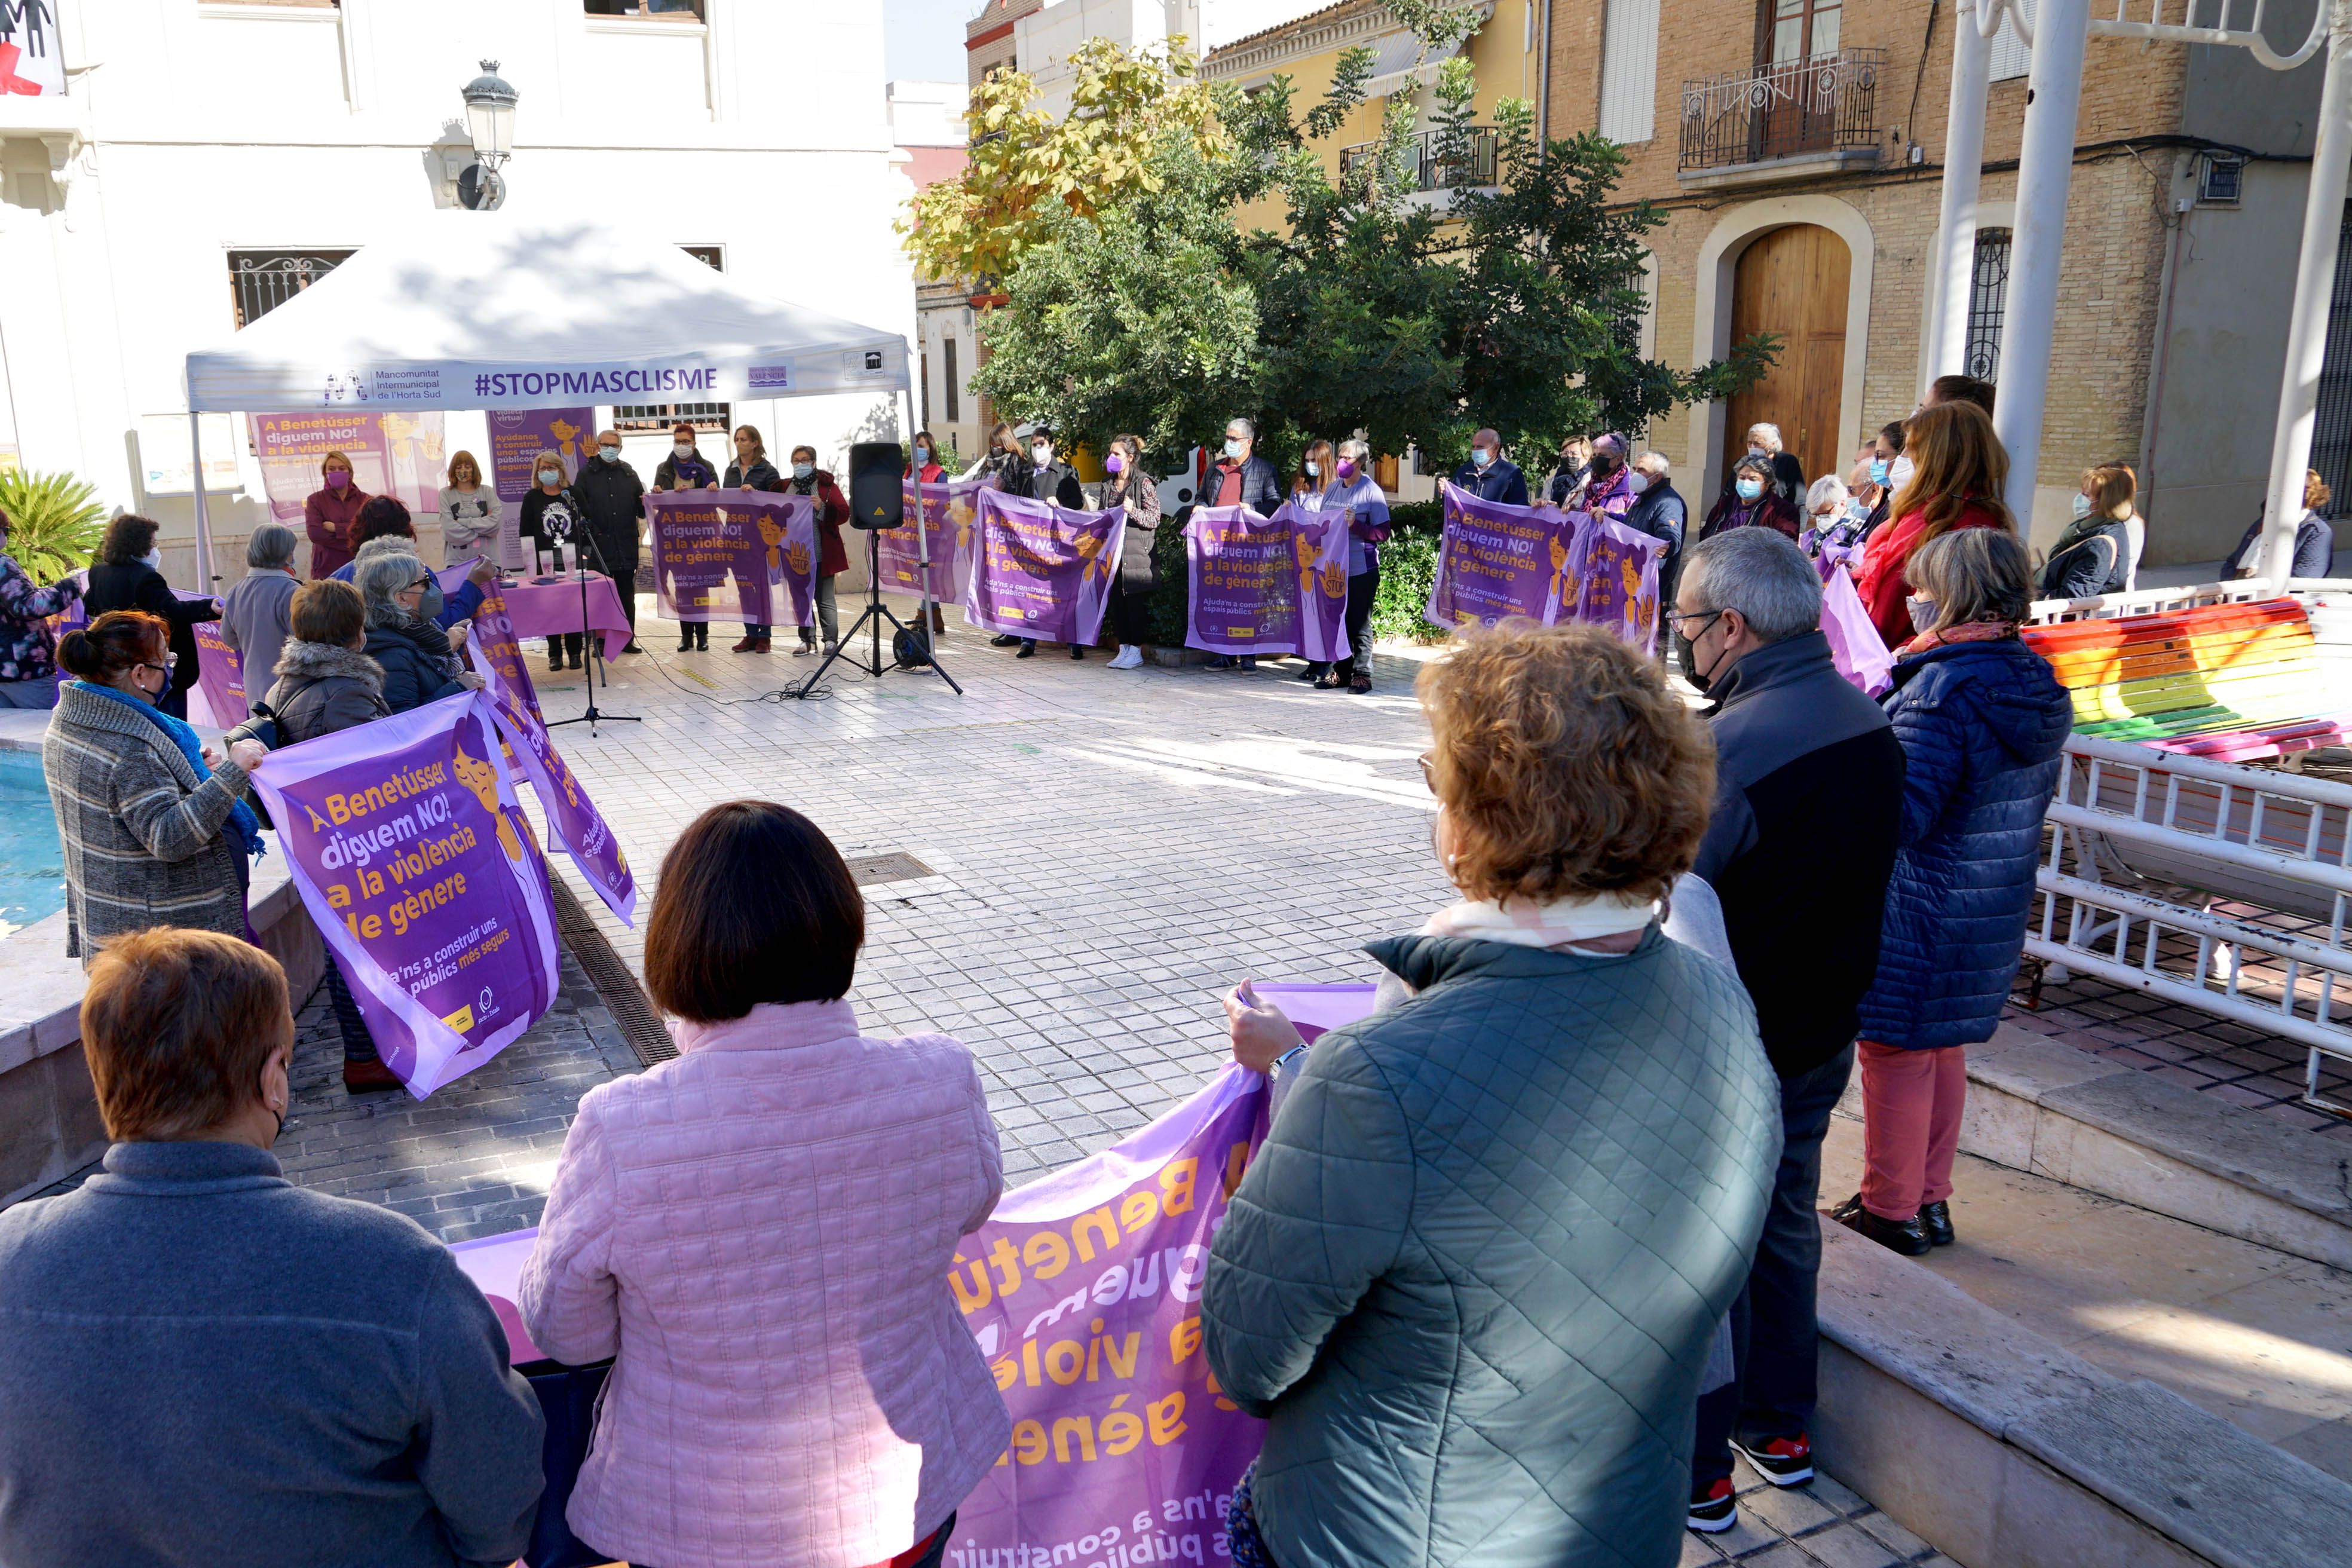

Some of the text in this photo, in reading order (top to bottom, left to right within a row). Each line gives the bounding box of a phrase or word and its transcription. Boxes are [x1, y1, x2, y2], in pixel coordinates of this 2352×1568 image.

[376, 370, 439, 379] Mancomunitat
[475, 368, 718, 396] #STOPMASCLISME
[376, 380, 439, 389] Intermunicipal
[264, 416, 368, 431] A Benetússer
[267, 428, 358, 445] diguem NO!
[495, 433, 538, 442] Ayúdanos
[268, 440, 367, 455] a la violència
[268, 457, 287, 468] de
[497, 456, 534, 465] públicos
[498, 463, 532, 472] seguros
[662, 512, 751, 523] A Benetsser
[1448, 509, 1545, 541] A Benetússer
[663, 525, 742, 538] diguem NO!
[985, 513, 1071, 540] A Benetússer
[664, 536, 750, 549] a la violència
[985, 526, 1059, 553] diguem NO!
[1204, 529, 1291, 543] A Benetússe
[1447, 523, 1534, 555] diguem NO!
[665, 550, 734, 564] de gènere
[994, 541, 1063, 567] la violència
[1205, 543, 1287, 559] diguem NO!
[1454, 539, 1537, 572] la violència
[792, 558, 808, 571] STOP
[1002, 557, 1049, 575] gènere
[1204, 558, 1294, 573] a la violència
[1460, 557, 1515, 581] gènere
[1204, 572, 1275, 590] de gènere
[1326, 579, 1345, 593] STOP
[1000, 587, 1025, 598] públics
[1015, 584, 1046, 595] construir
[1472, 587, 1508, 601] construir
[1509, 596, 1523, 605] uns
[1203, 605, 1226, 614] espais
[1226, 607, 1252, 615] públics
[1239, 599, 1273, 608] construir
[1455, 590, 1527, 614] públics més segurs
[477, 616, 512, 641] NO
[304, 760, 448, 833] A Benetússer
[321, 791, 452, 870] diguem NO!
[326, 822, 477, 909] a la violència
[388, 871, 466, 936] gènere
[390, 917, 498, 984] a'ns a construir uns
[410, 927, 510, 999] públics més segurs
